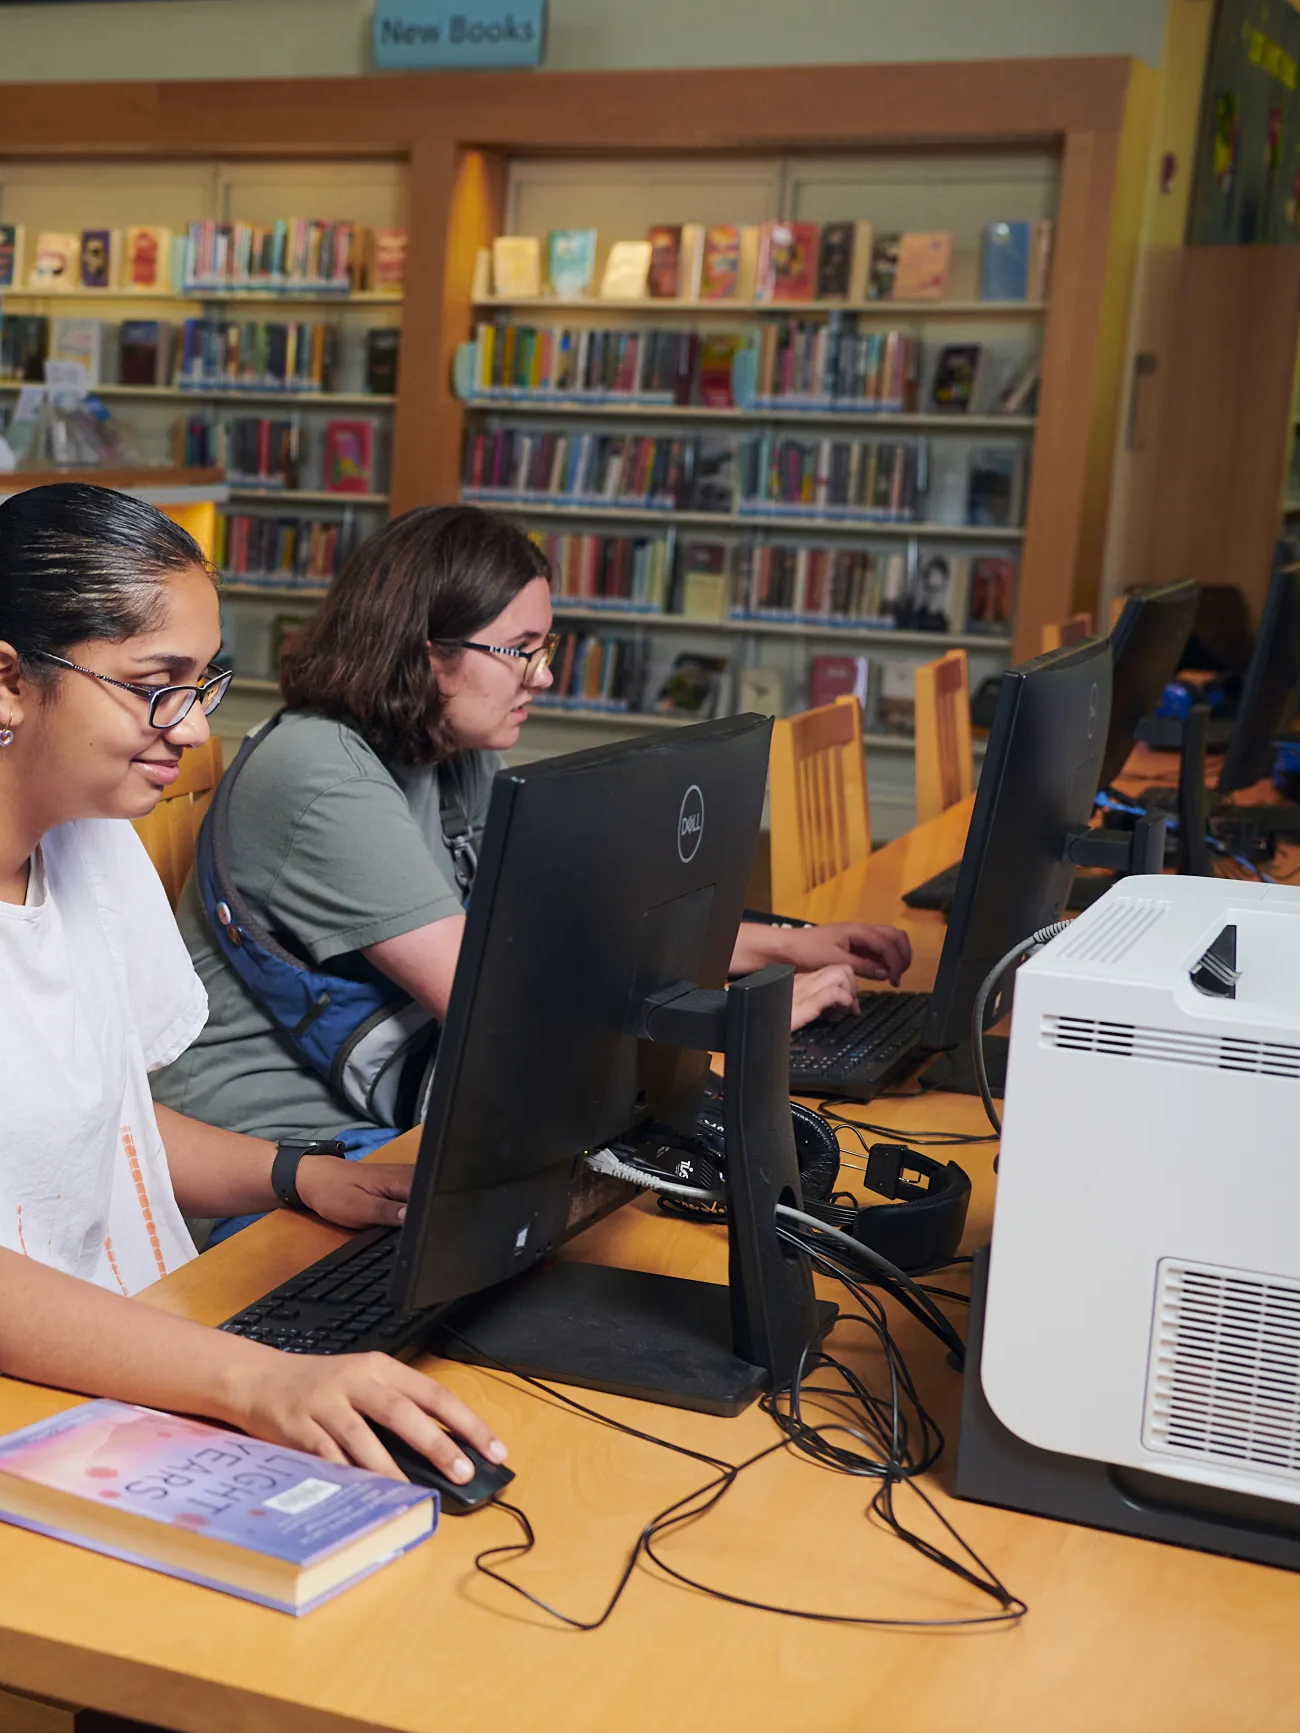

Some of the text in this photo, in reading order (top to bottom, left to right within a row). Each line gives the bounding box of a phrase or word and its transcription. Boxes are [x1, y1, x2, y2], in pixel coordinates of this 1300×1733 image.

[380, 12, 536, 46] New Books
[681, 813, 701, 836] DELL
[125, 1440, 267, 1500] YEARS
[187, 1454, 312, 1516] LIGHT
